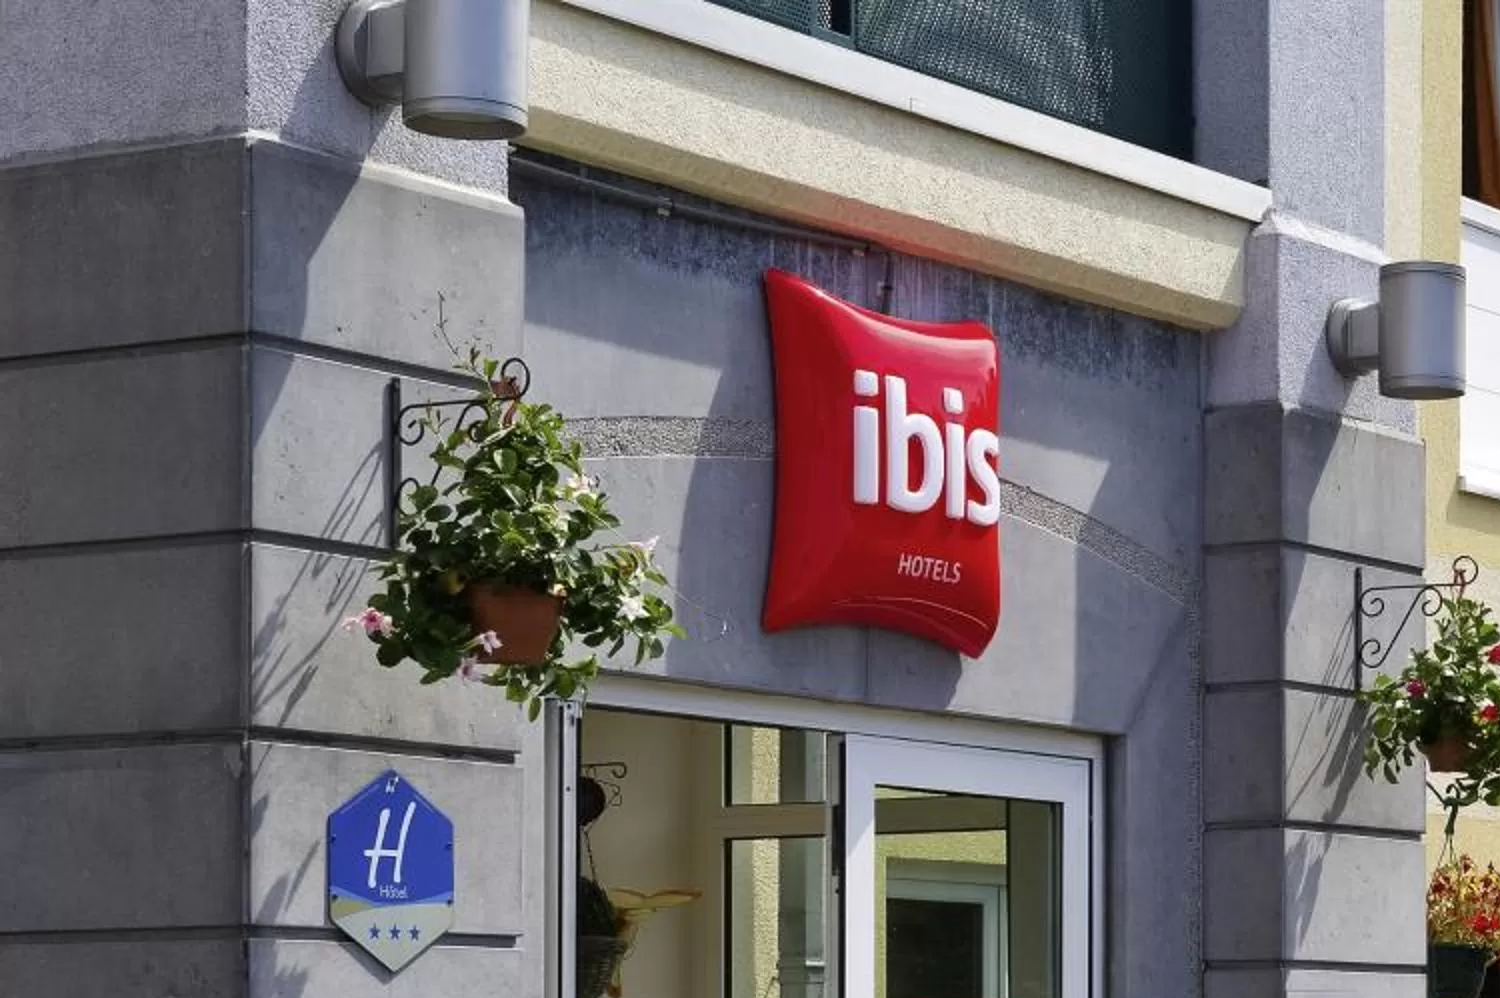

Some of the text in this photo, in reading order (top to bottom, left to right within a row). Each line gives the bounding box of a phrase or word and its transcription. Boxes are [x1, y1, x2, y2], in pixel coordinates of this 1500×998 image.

[853, 369, 1000, 526] ibis
[897, 553, 961, 584] HOTELS
[364, 801, 416, 888] H
